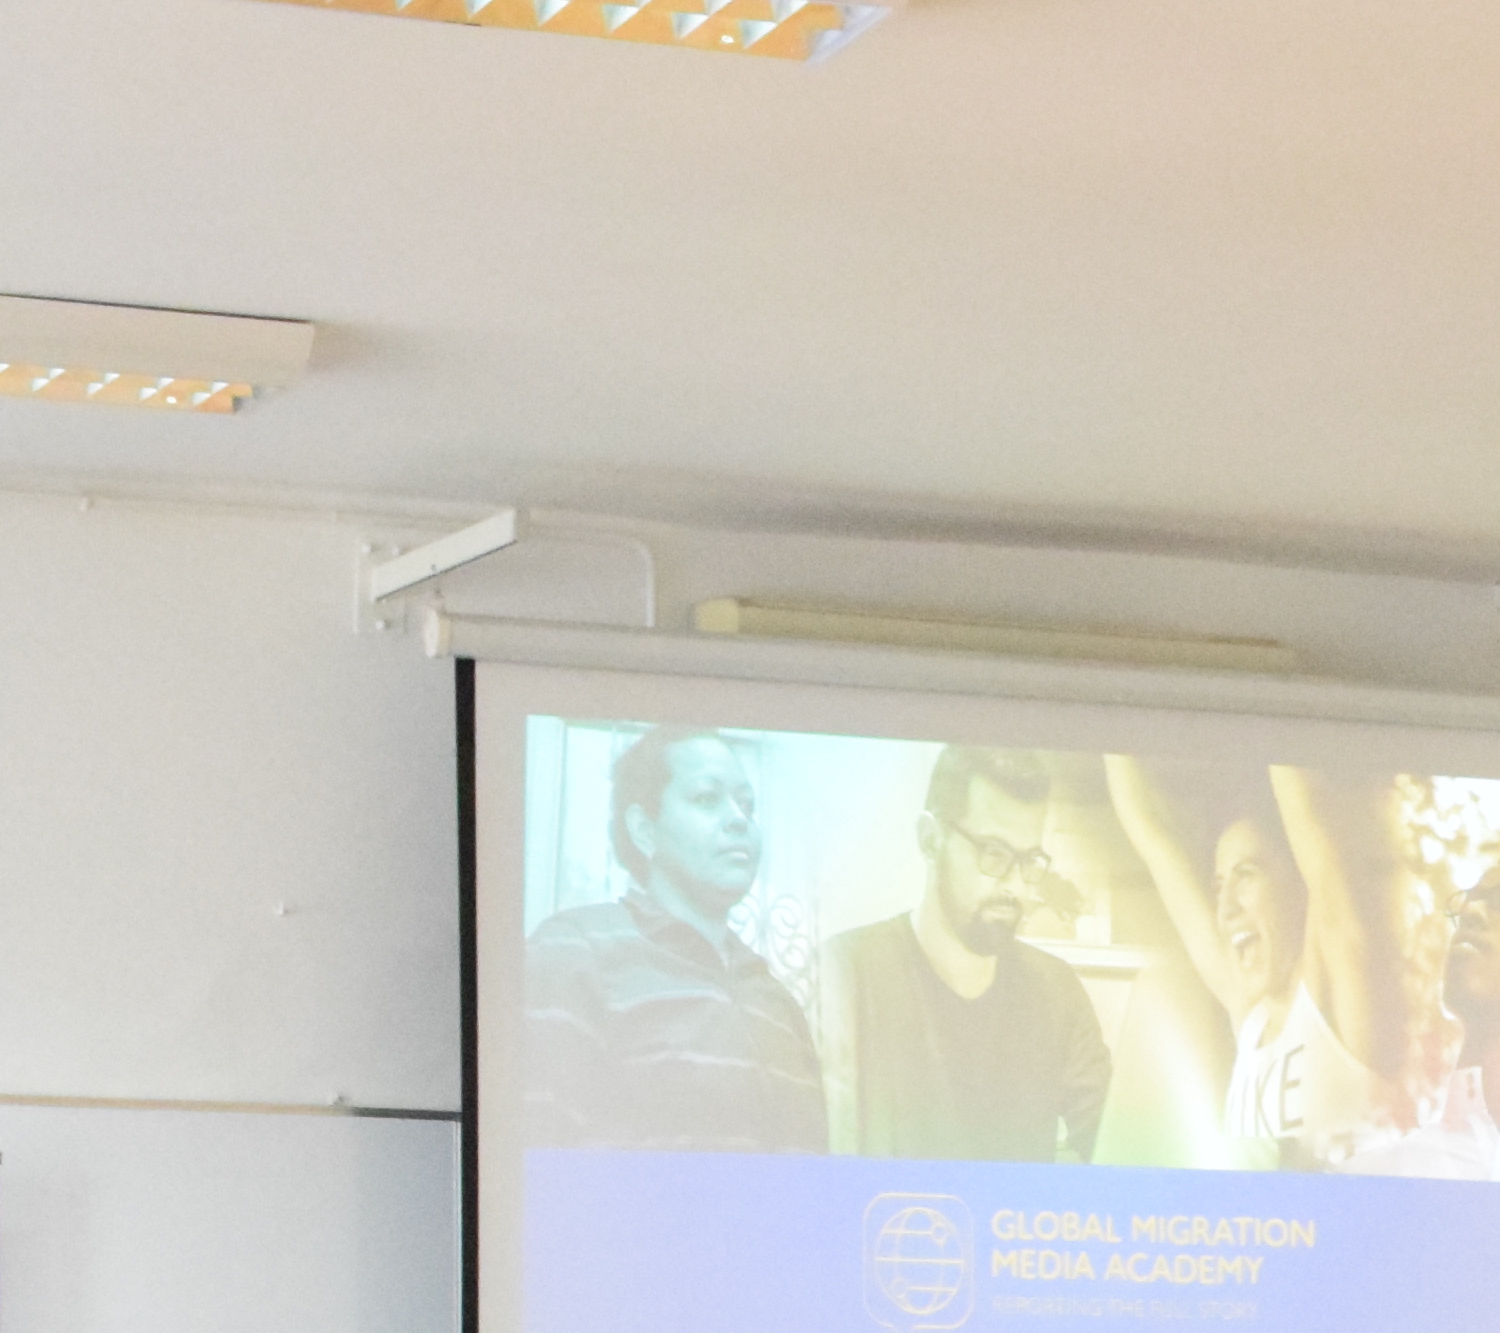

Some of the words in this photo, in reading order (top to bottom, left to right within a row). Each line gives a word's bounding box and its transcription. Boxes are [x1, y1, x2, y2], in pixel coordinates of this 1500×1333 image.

[991, 1210, 1121, 1244] GLOBAL
[1131, 1214, 1317, 1249] MIGRATION
[991, 1249, 1095, 1281] MEDIA
[1105, 1253, 1264, 1286] ACADEMY
